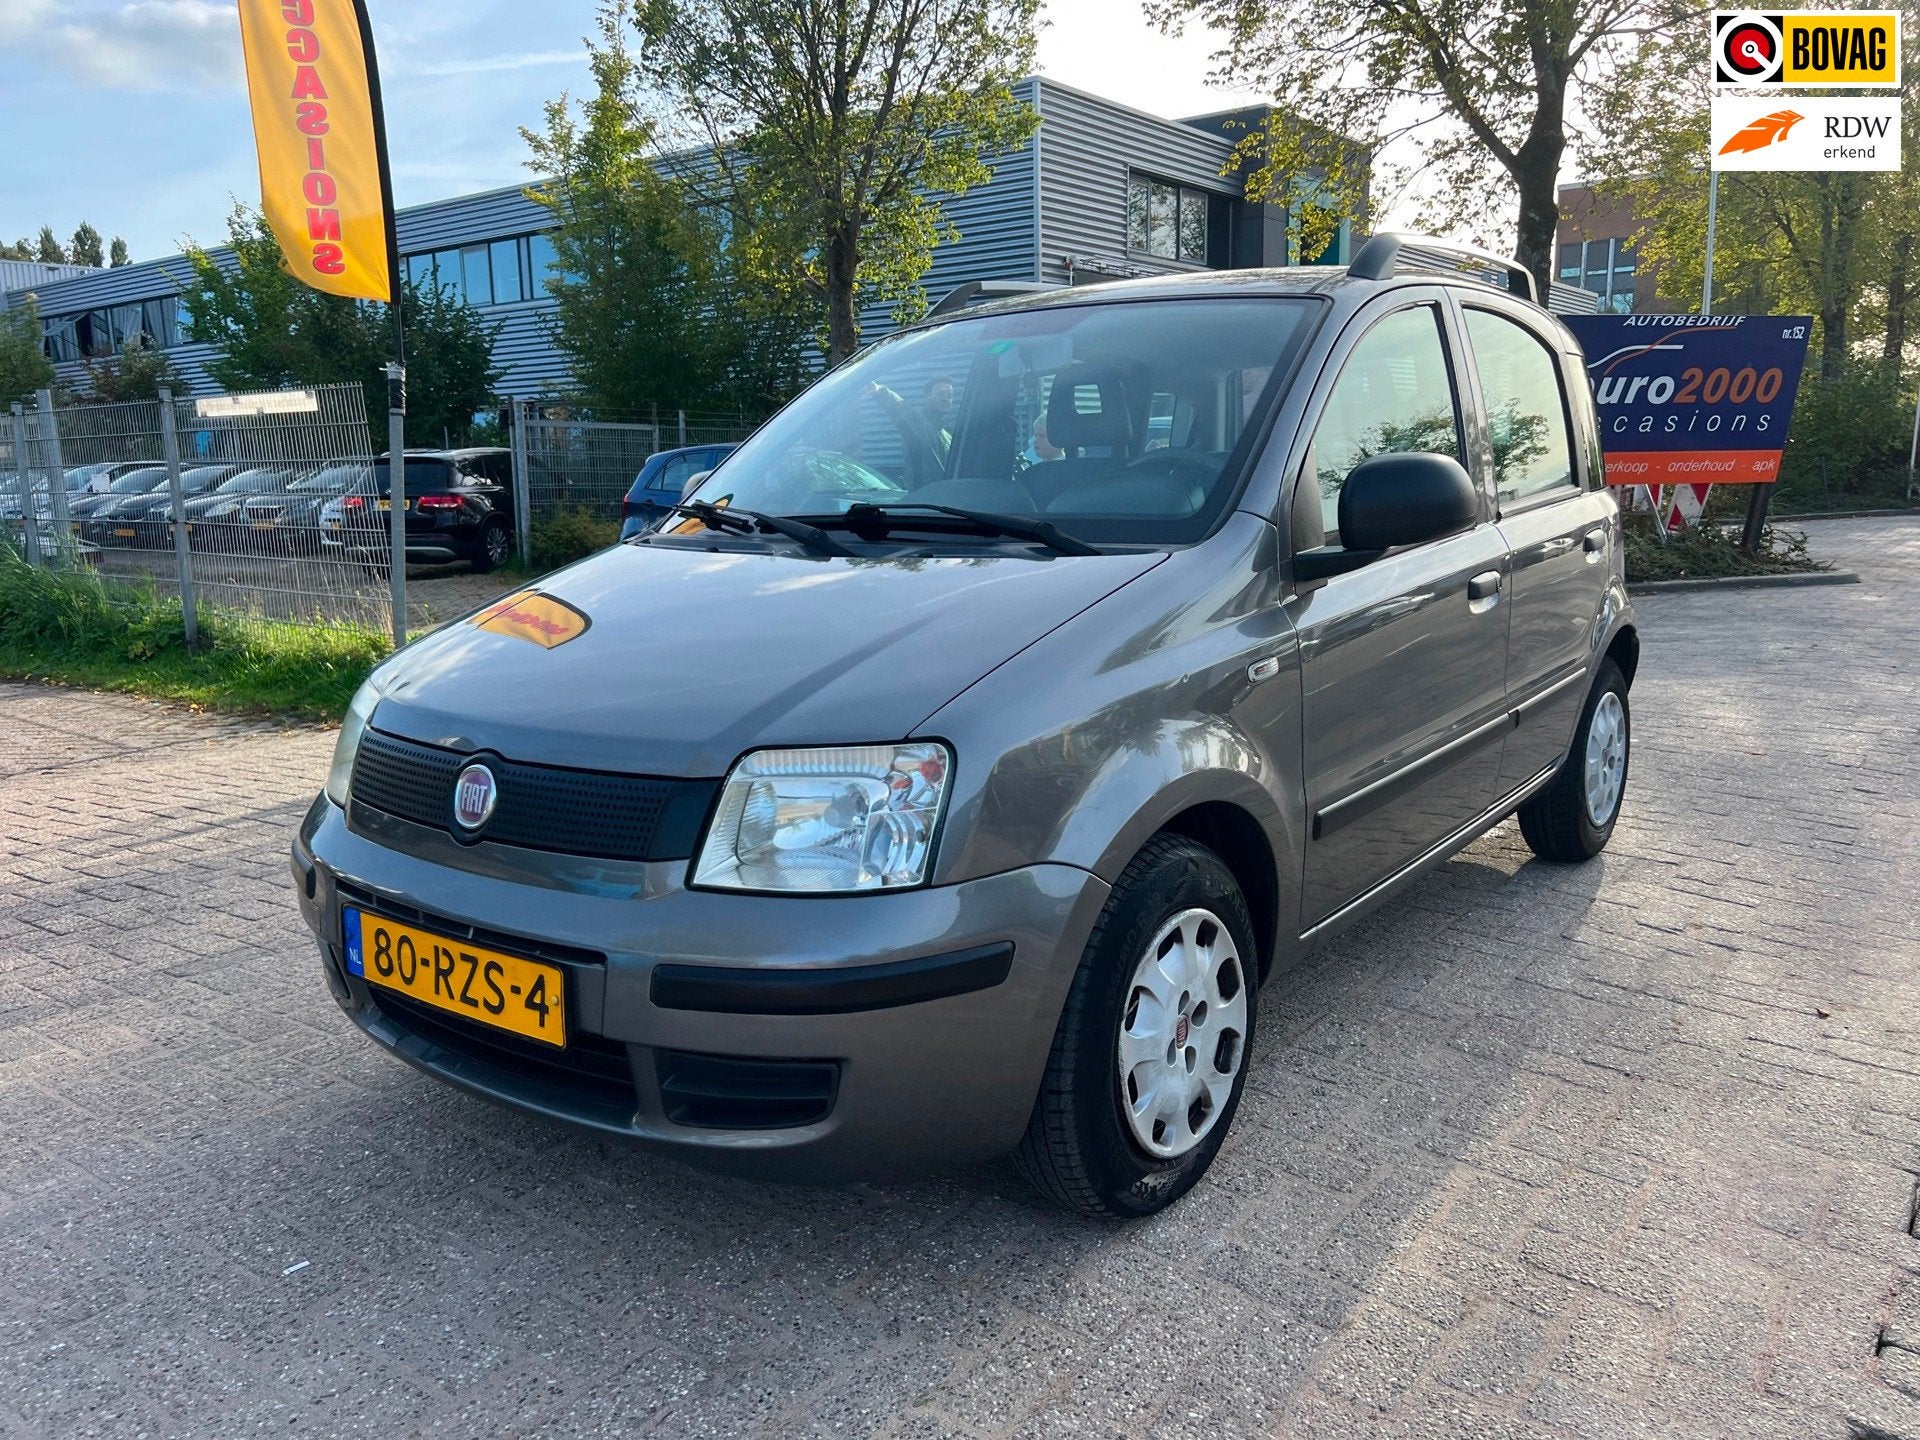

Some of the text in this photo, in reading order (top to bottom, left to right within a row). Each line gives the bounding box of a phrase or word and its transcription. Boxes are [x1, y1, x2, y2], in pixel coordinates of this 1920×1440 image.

[1623, 315, 1747, 327] AUTOBEDRIJF
[1590, 367, 1783, 404] uro2000
[1598, 410, 1771, 433] casions
[1605, 459, 1775, 474] erkoop onderhoud apk
[461, 781, 488, 814] FIAT
[349, 947, 362, 965] NL
[374, 927, 550, 1028] 80-RZS-4
